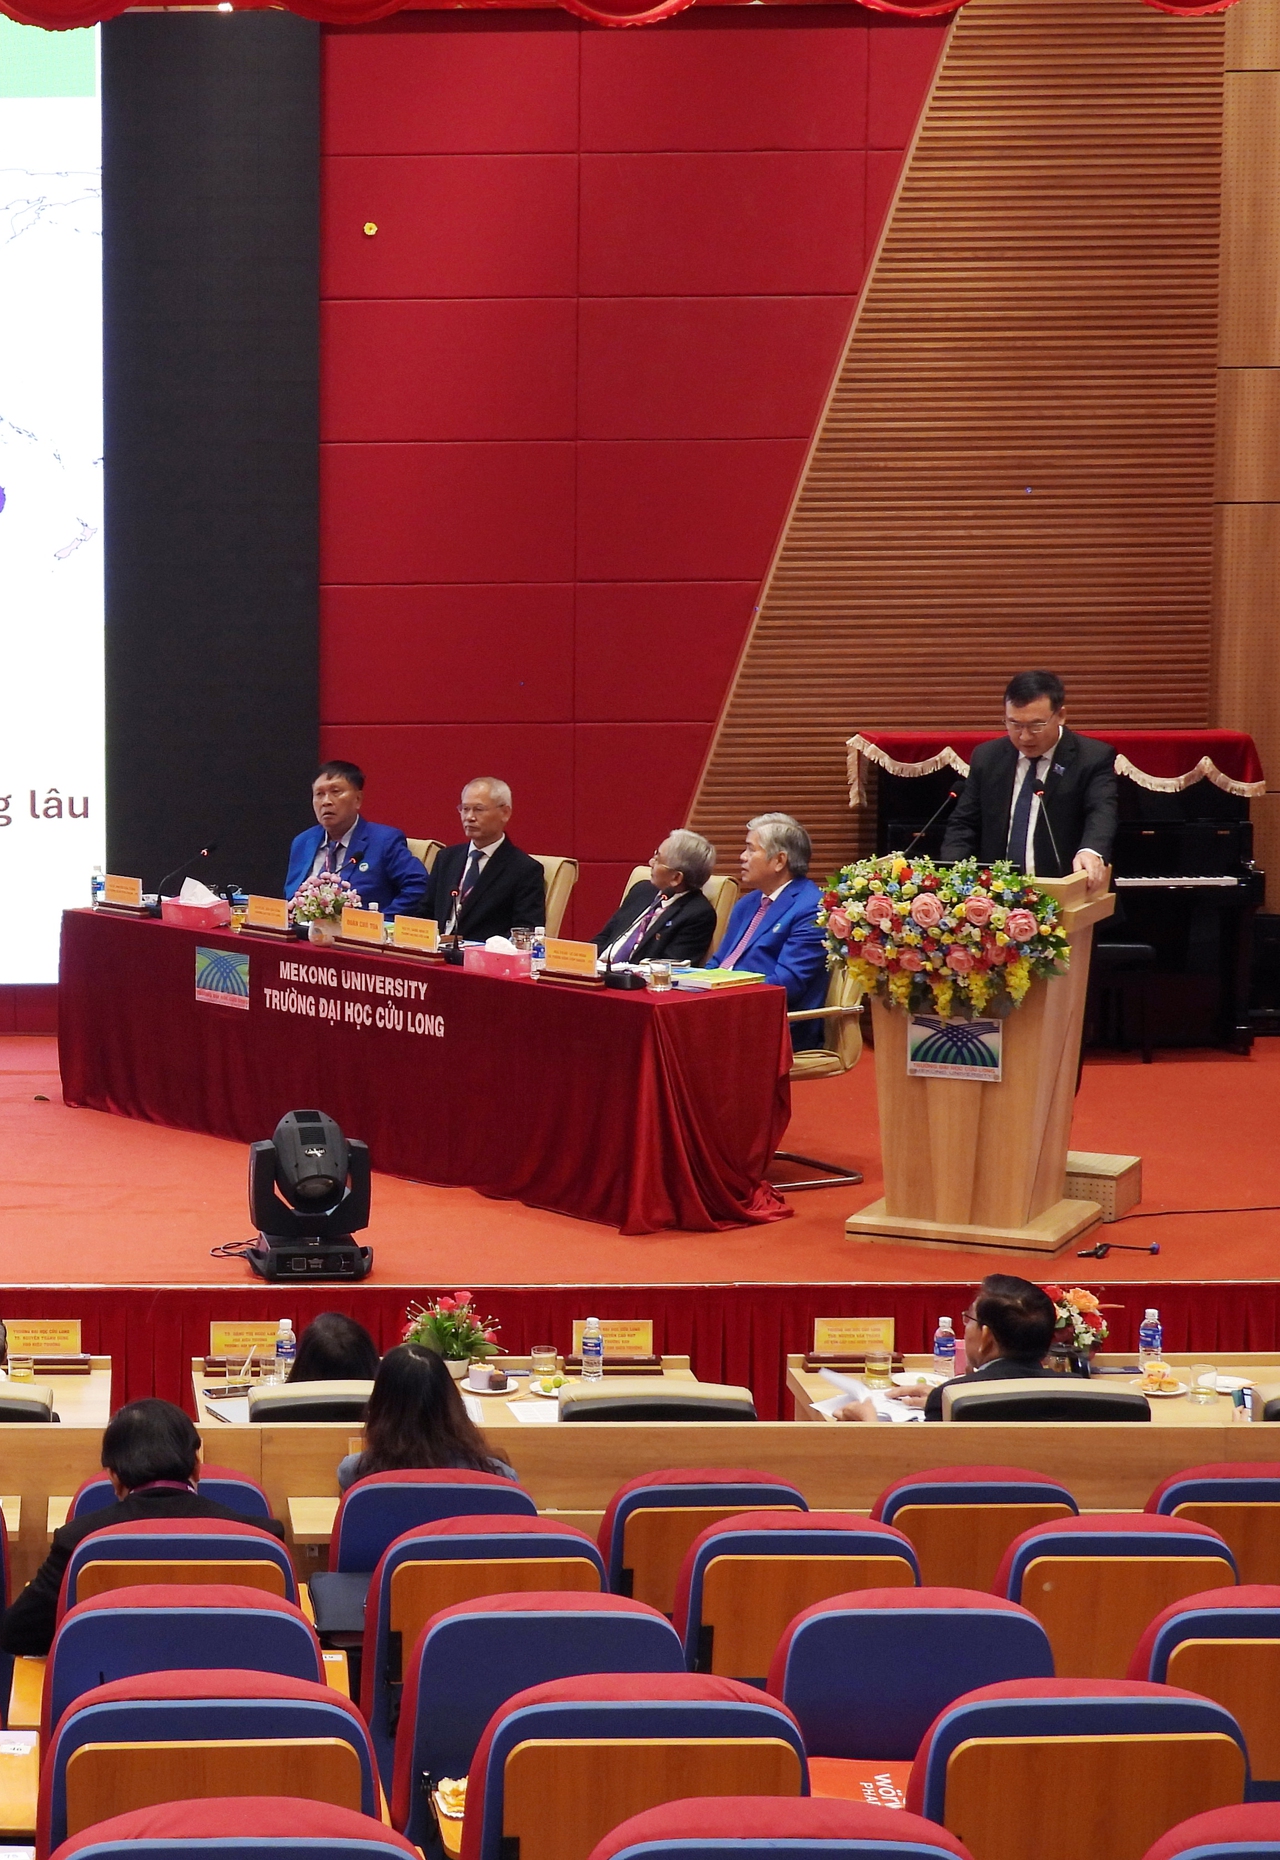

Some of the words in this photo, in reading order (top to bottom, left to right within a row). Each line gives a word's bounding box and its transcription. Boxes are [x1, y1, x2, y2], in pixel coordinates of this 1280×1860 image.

[31, 789, 89, 820] lâu
[280, 961, 337, 987] MEKONG
[341, 969, 428, 1001] UNIVERSITY
[264, 987, 315, 1017] TRƯỜNG
[319, 998, 341, 1026] ĐẠI
[345, 1001, 372, 1030] HỌC
[376, 1000, 404, 1031] CỬU
[408, 1012, 445, 1037] LONG
